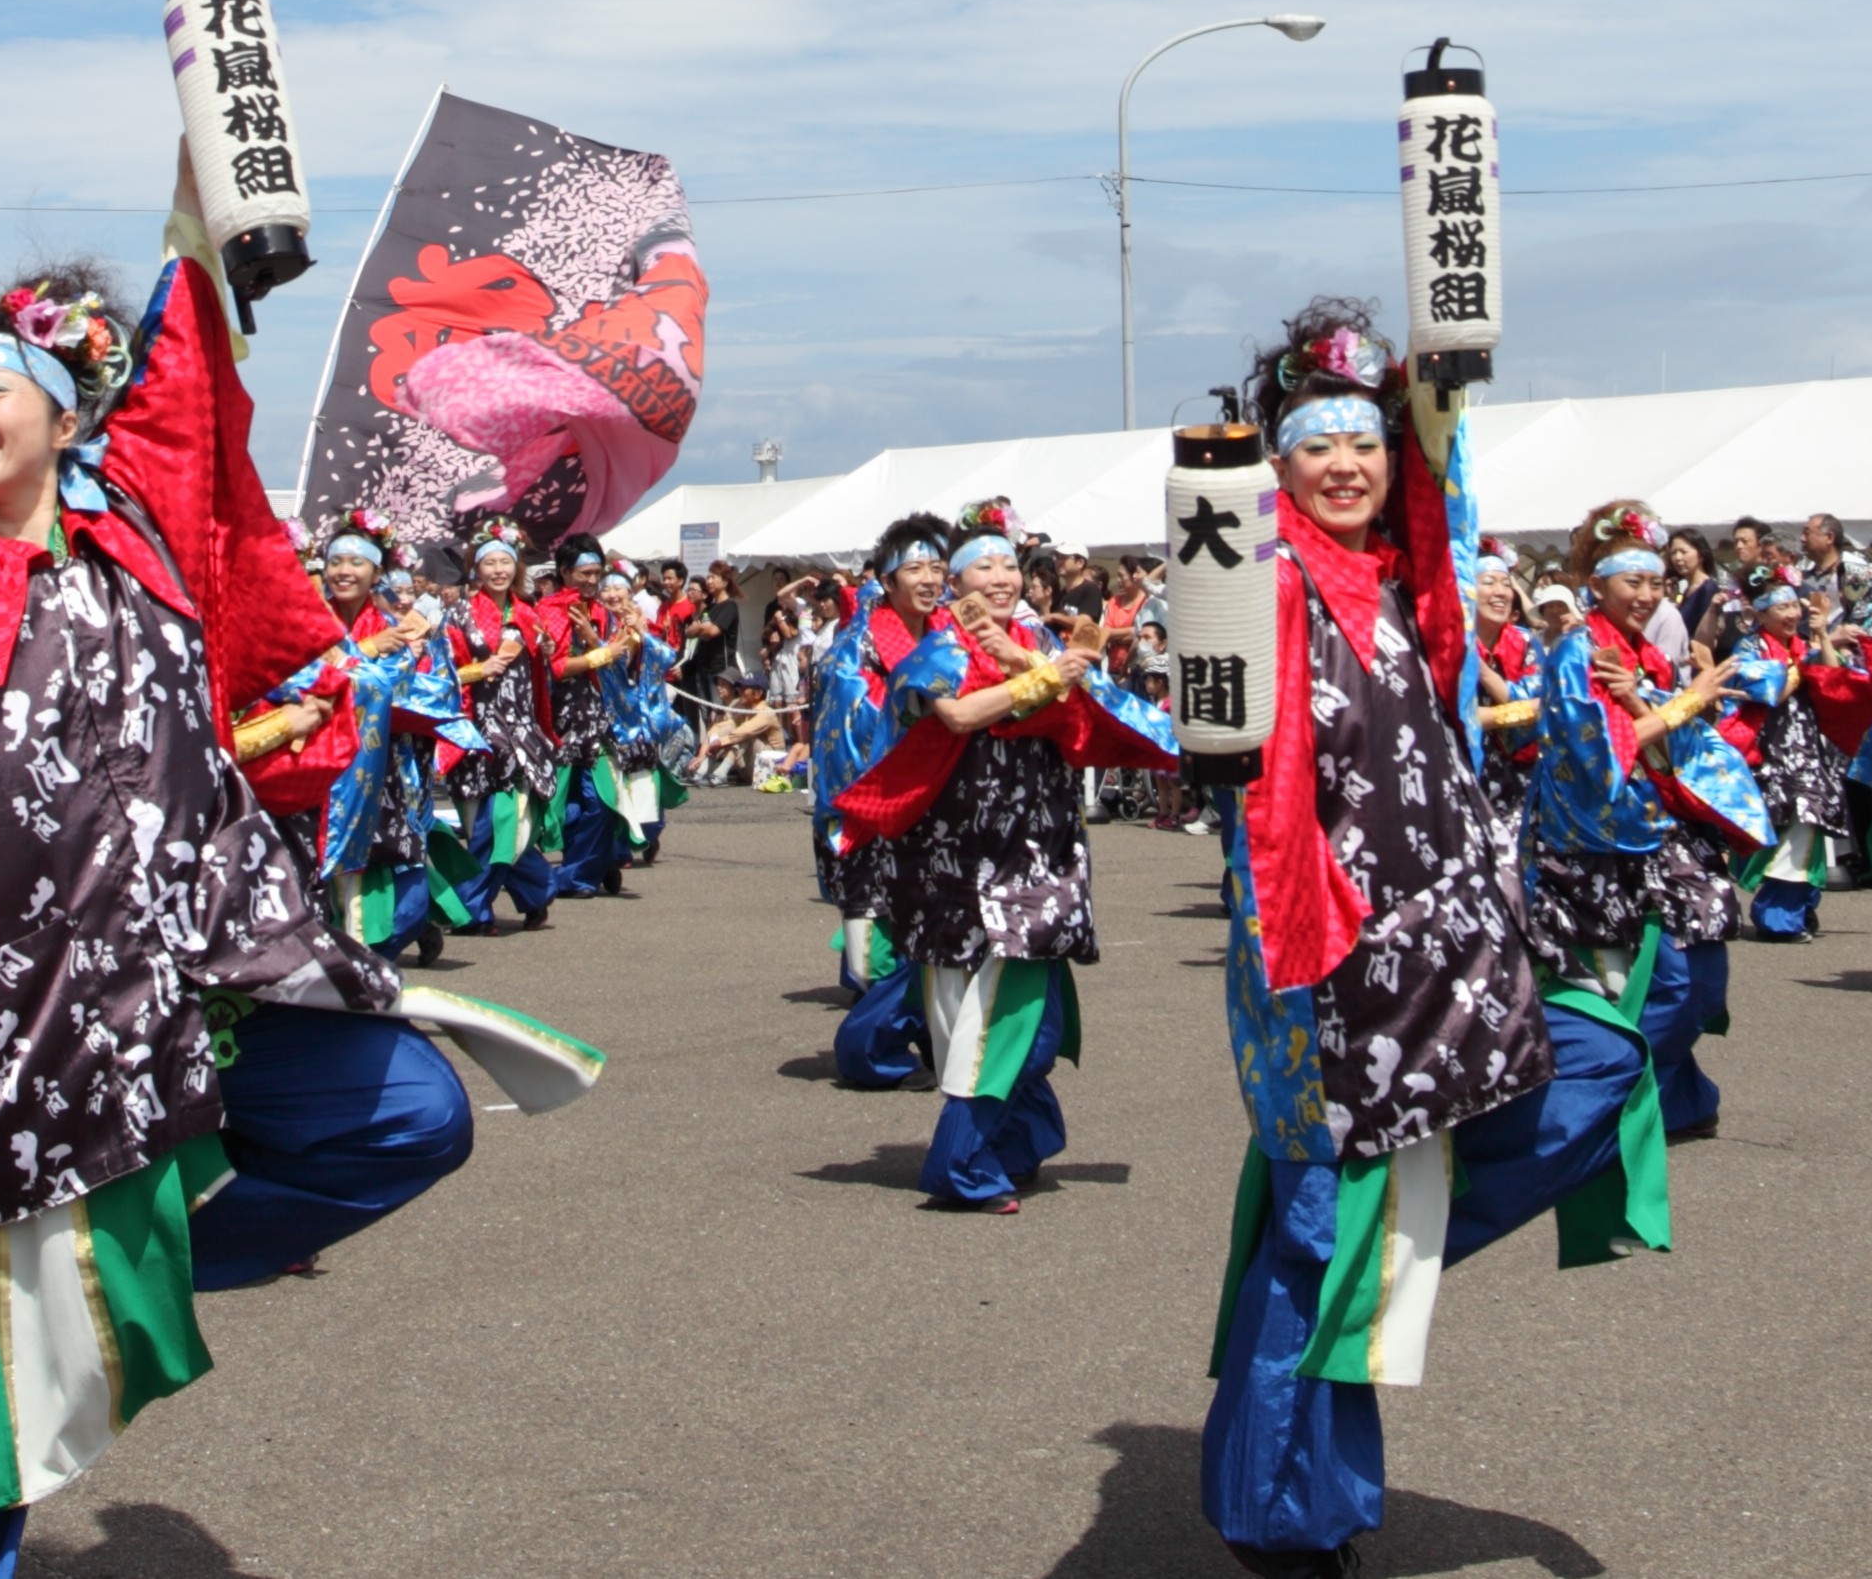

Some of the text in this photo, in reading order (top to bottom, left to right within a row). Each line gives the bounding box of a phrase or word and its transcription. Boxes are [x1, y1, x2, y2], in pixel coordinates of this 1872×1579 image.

[1426, 114, 1489, 323] 花嵐桜組
[1178, 495, 1247, 730] 大間
